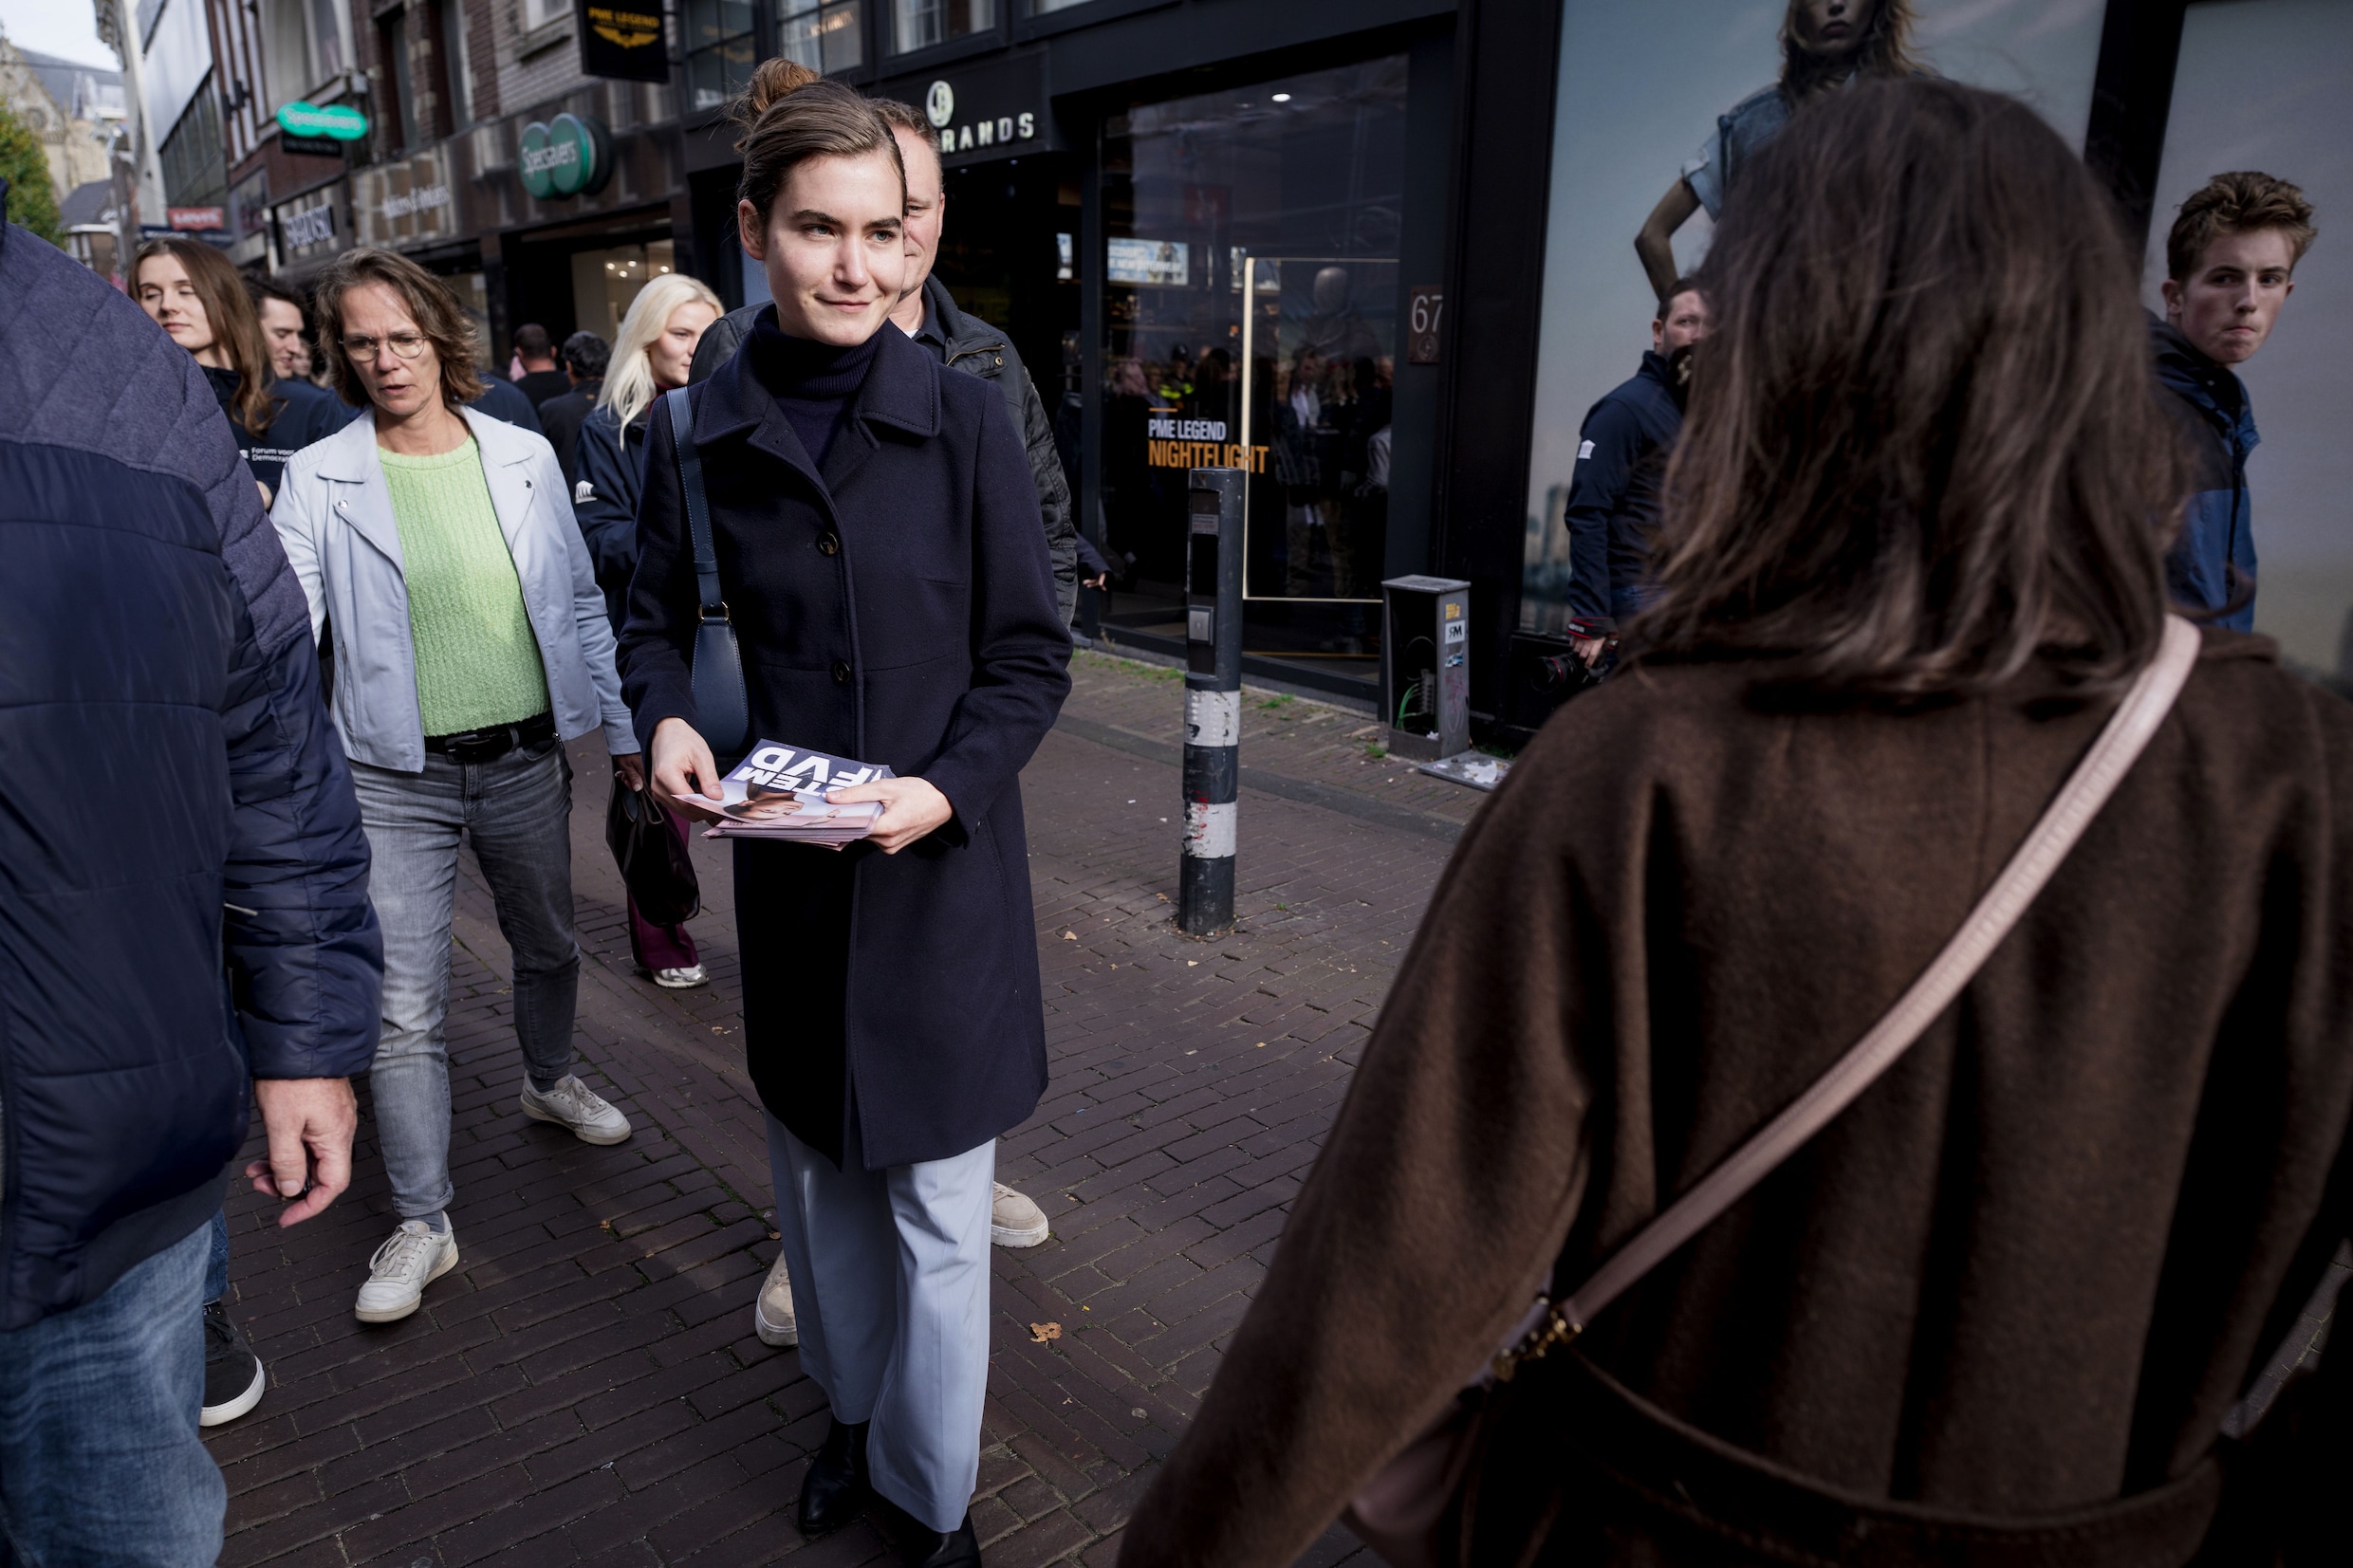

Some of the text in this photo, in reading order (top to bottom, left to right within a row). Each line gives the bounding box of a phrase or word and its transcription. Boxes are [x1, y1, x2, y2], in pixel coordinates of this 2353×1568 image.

[616, 11, 660, 29] LEGEND
[285, 107, 361, 131] Specsavers
[940, 112, 1034, 154] RANDS
[522, 140, 577, 178] Specsavers
[1412, 295, 1443, 333] 67
[1148, 418, 1227, 442] PME LEGEND
[1148, 440, 1269, 473] NIGHTFLIGHT
